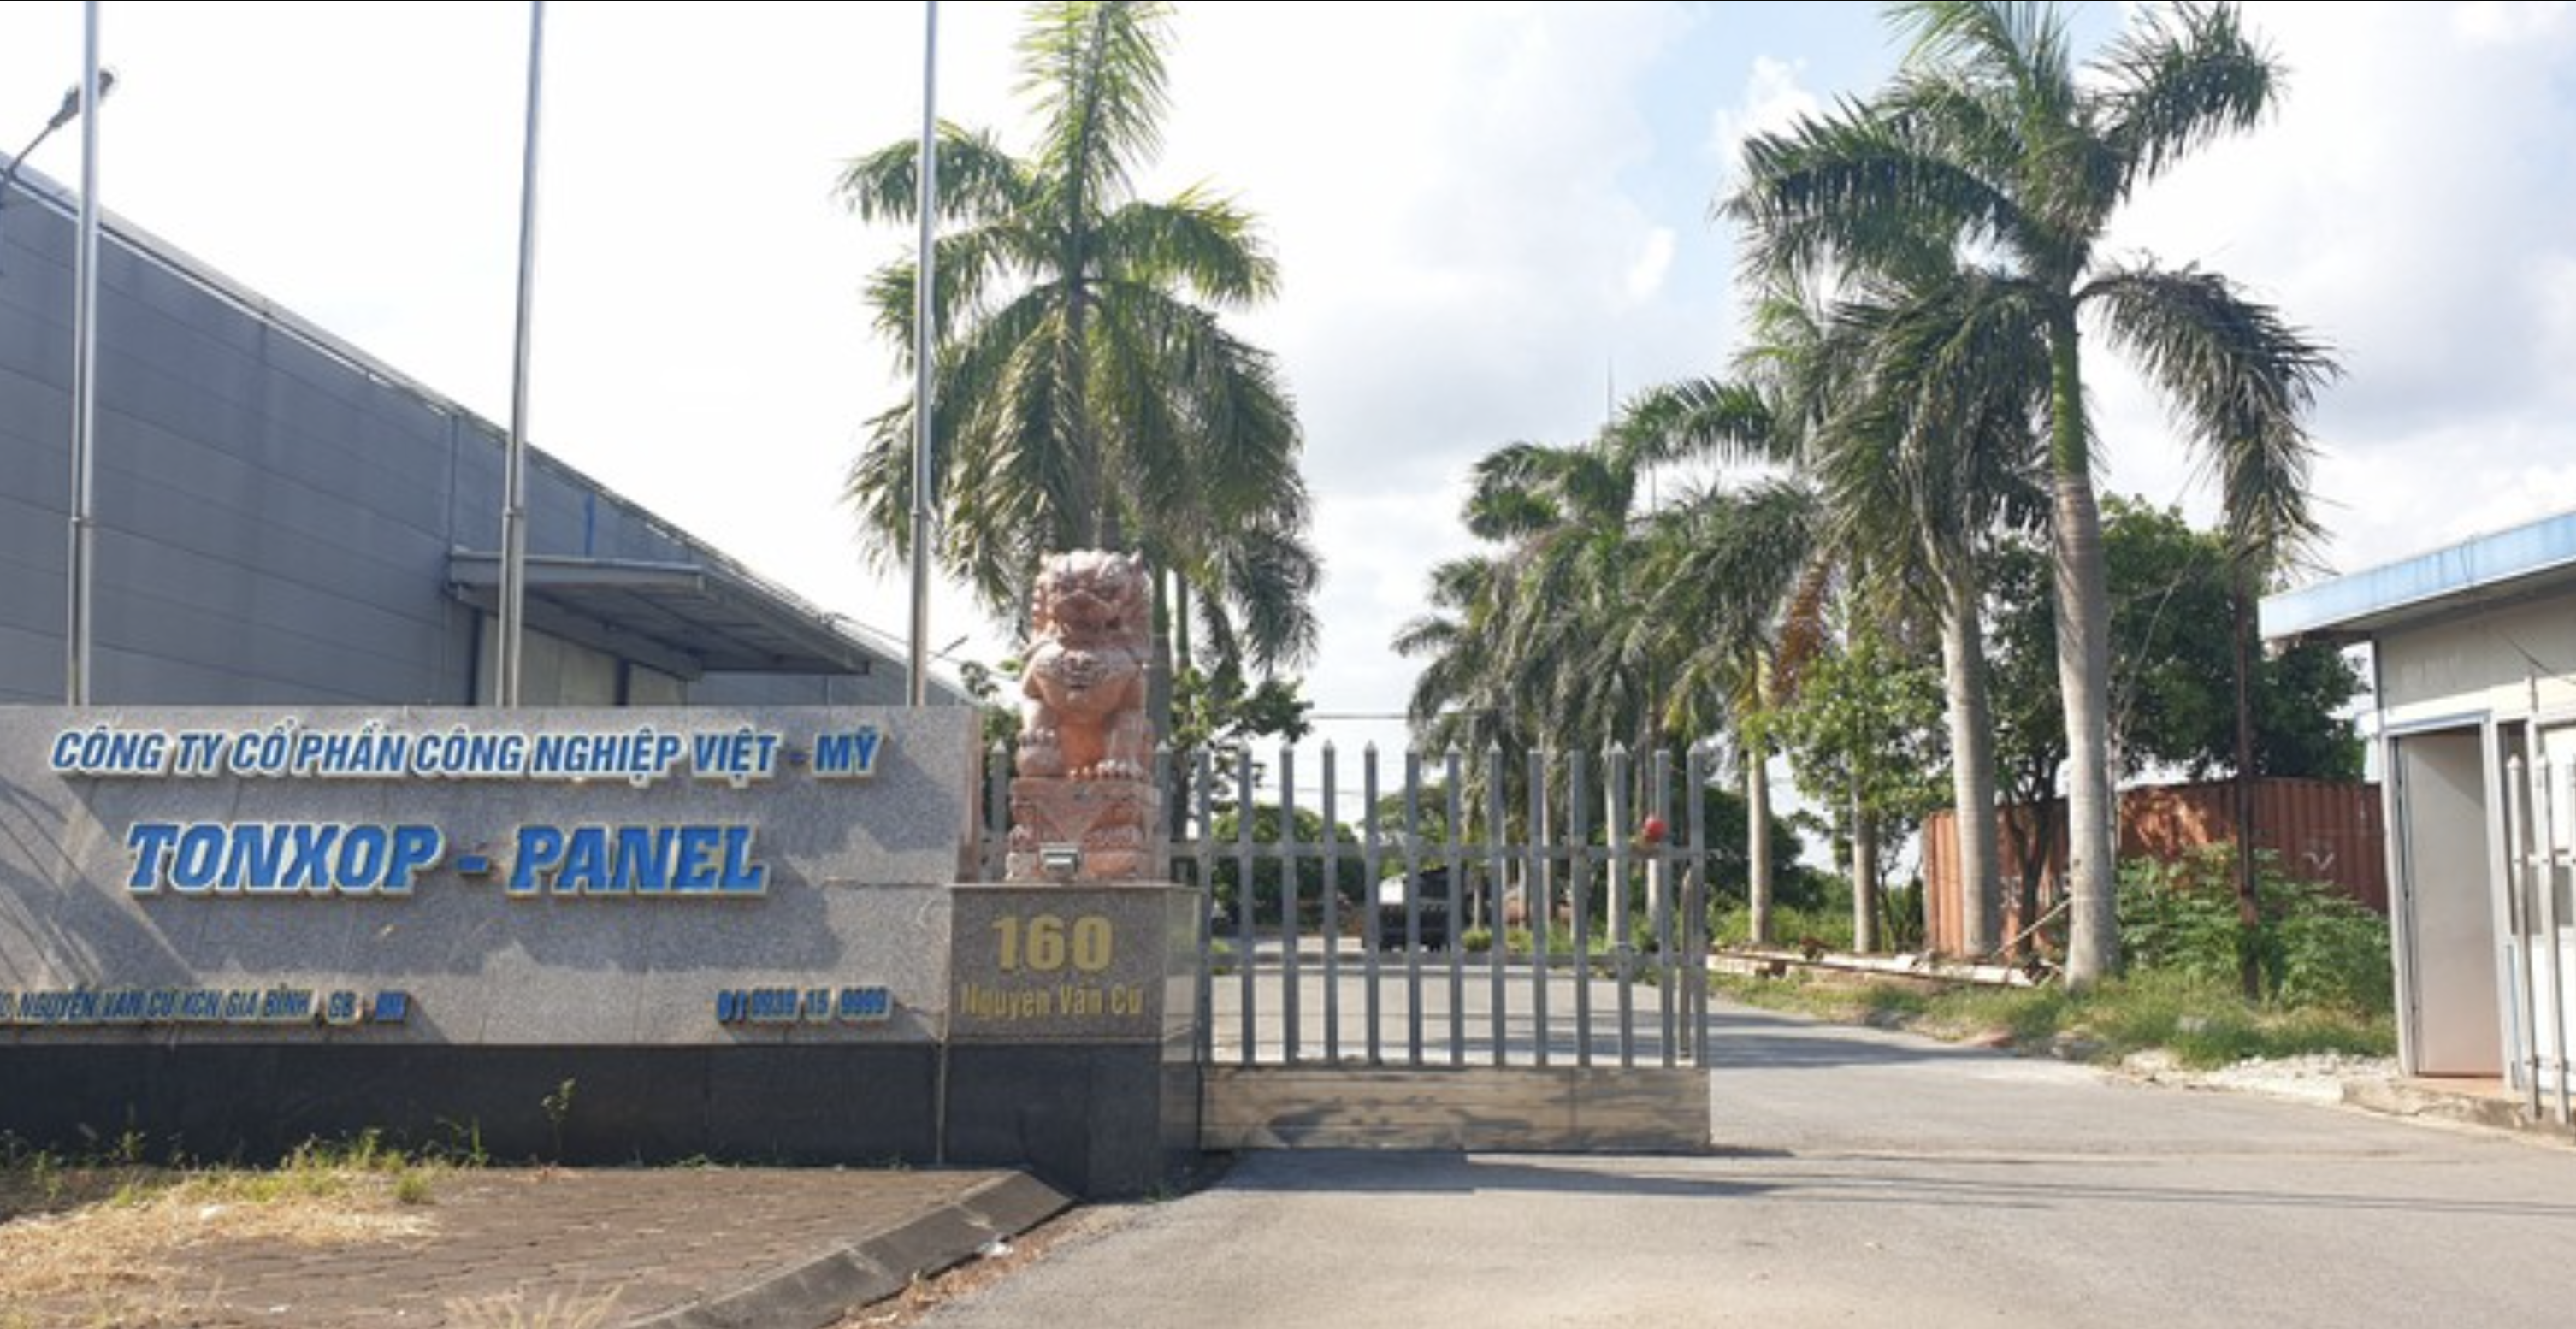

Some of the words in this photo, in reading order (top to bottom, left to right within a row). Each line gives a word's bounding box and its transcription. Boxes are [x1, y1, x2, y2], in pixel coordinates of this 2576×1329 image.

[51, 724, 168, 771] CÔNG
[175, 730, 224, 773] TY
[414, 725, 527, 773] CÔNG
[531, 726, 684, 785] NGHIỆP
[691, 725, 782, 785] VIỆT
[813, 725, 882, 775] MỸ
[127, 821, 443, 895] TONXOP
[507, 823, 769, 895] PANEL
[991, 913, 1114, 972] 160
